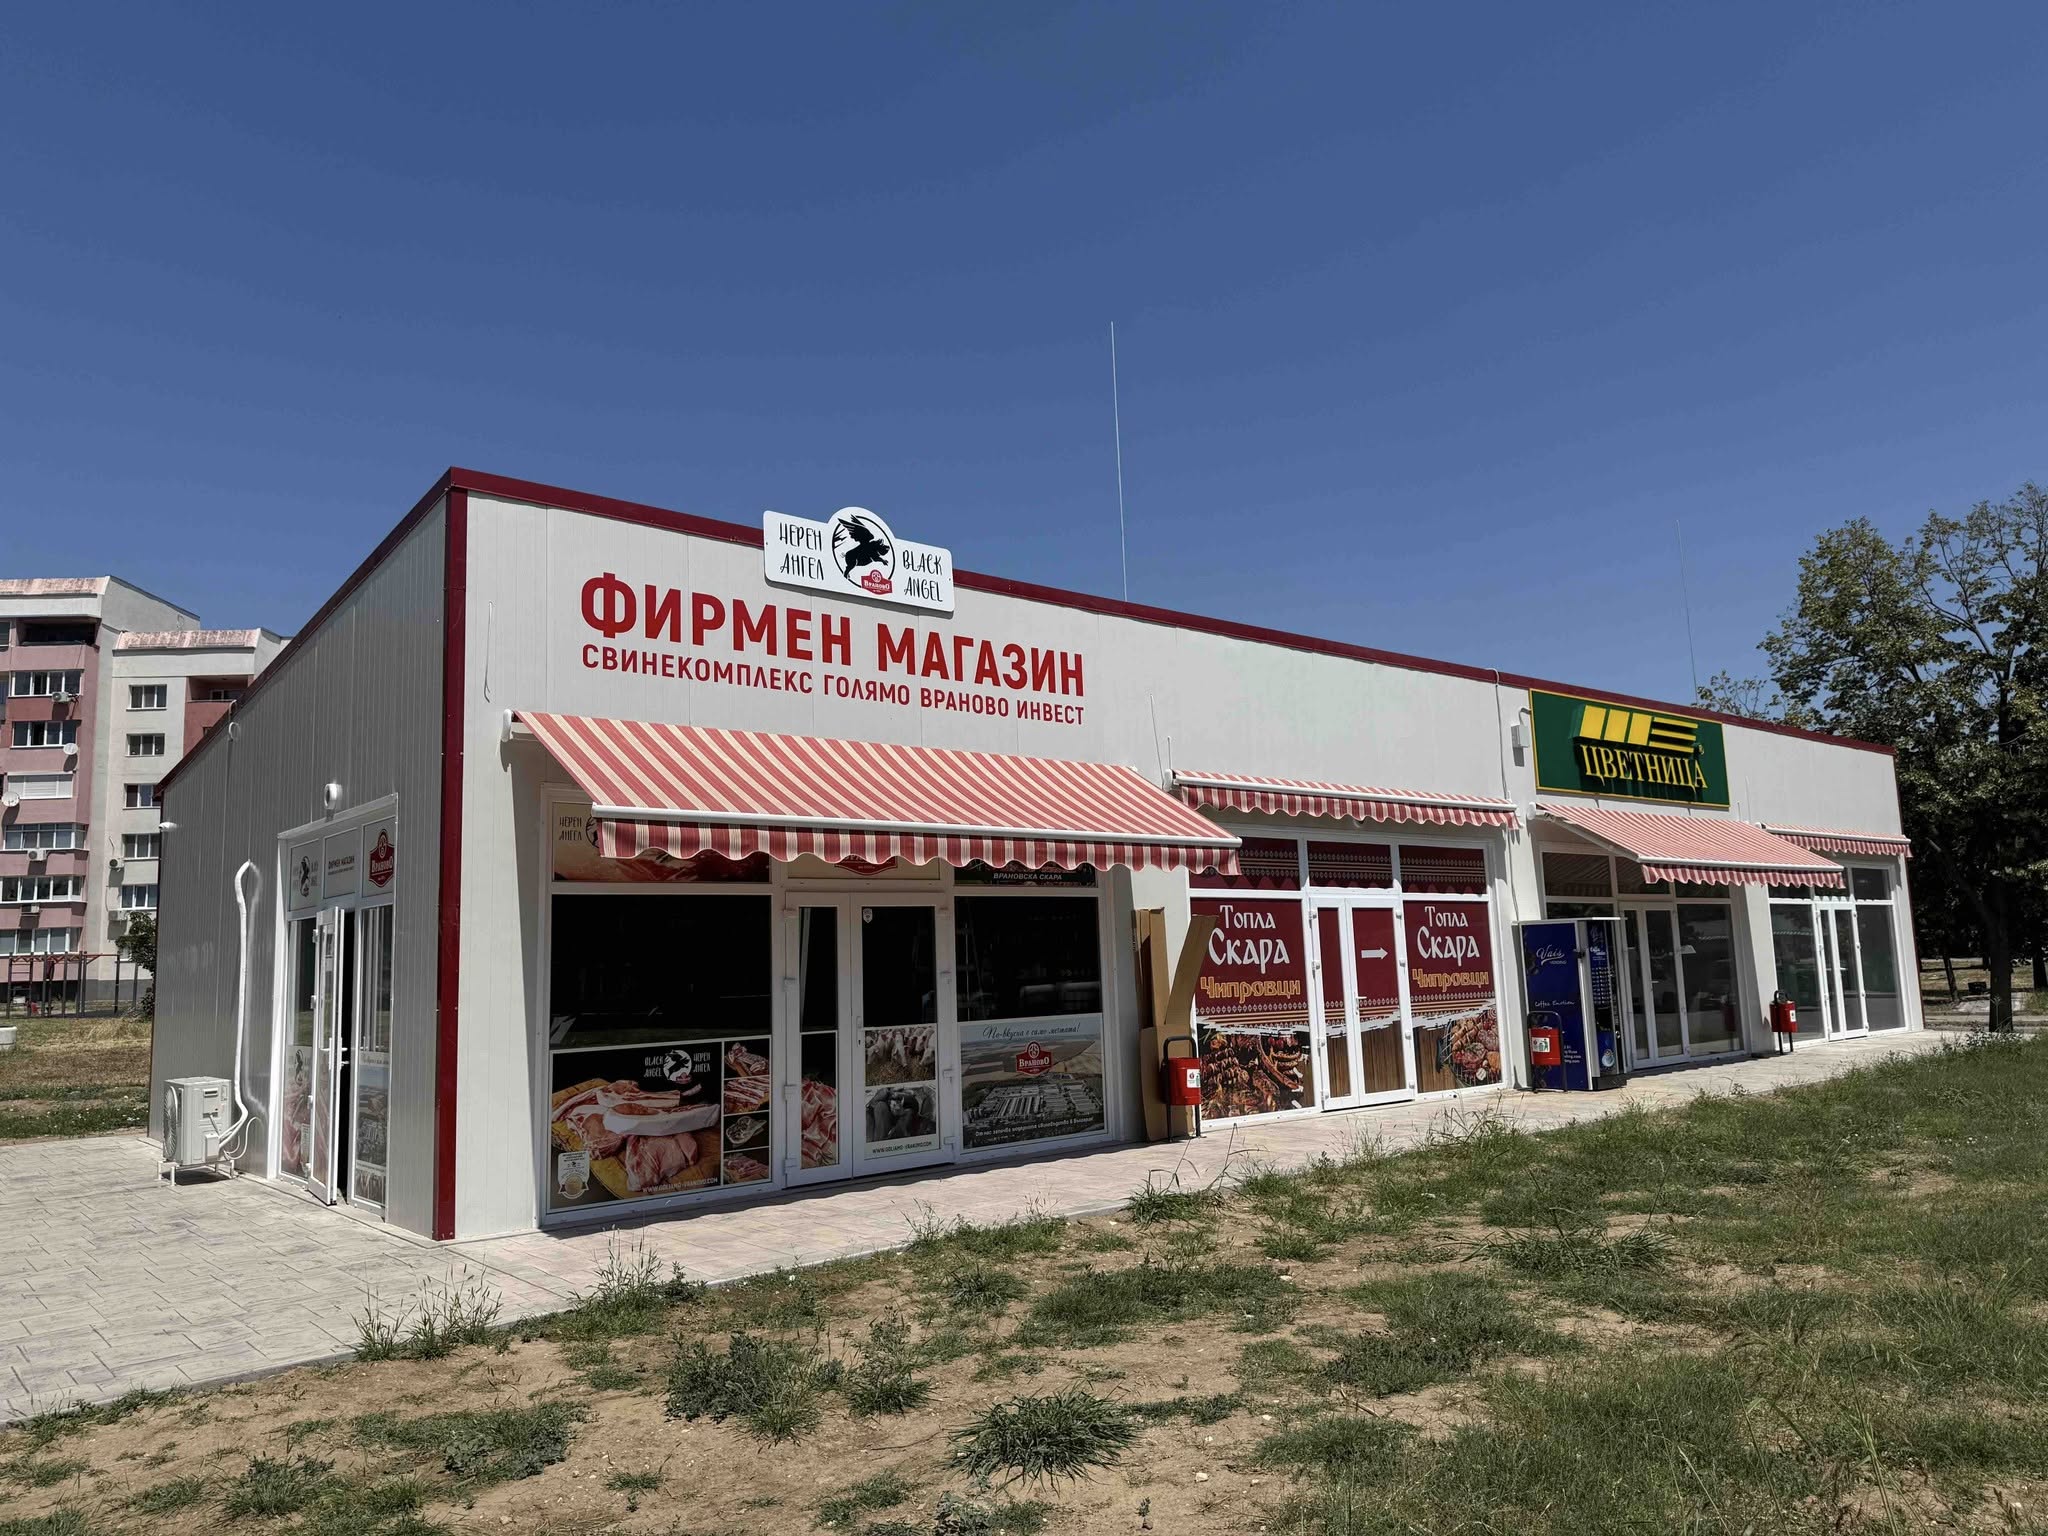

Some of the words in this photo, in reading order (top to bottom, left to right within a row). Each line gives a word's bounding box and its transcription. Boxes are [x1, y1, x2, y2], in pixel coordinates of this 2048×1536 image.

[779, 522, 822, 551] ЧЕРЕН
[780, 553, 824, 580] АНГЕЛ
[902, 549, 942, 575] BLACK
[904, 576, 943, 602] ANGEL
[581, 572, 851, 666] ФИРМЕН
[877, 622, 1085, 697] МАГАЗИН
[581, 644, 813, 694] СВИНЕКОМПЛЕКС
[823, 675, 910, 706] ГОЛЯМО
[920, 687, 1009, 718] ВРАНОВО
[1016, 700, 1084, 725] ИНВЕСТ
[1580, 744, 1708, 794] ЦВЕТНИЦА
[993, 872, 1038, 880] ВРАНОВСКА
[1039, 873, 1063, 881] СКАРА
[1200, 976, 1301, 1004] Чипровци
[1412, 968, 1489, 992] Чипровци
[1534, 1000, 1551, 1008] Coffee
